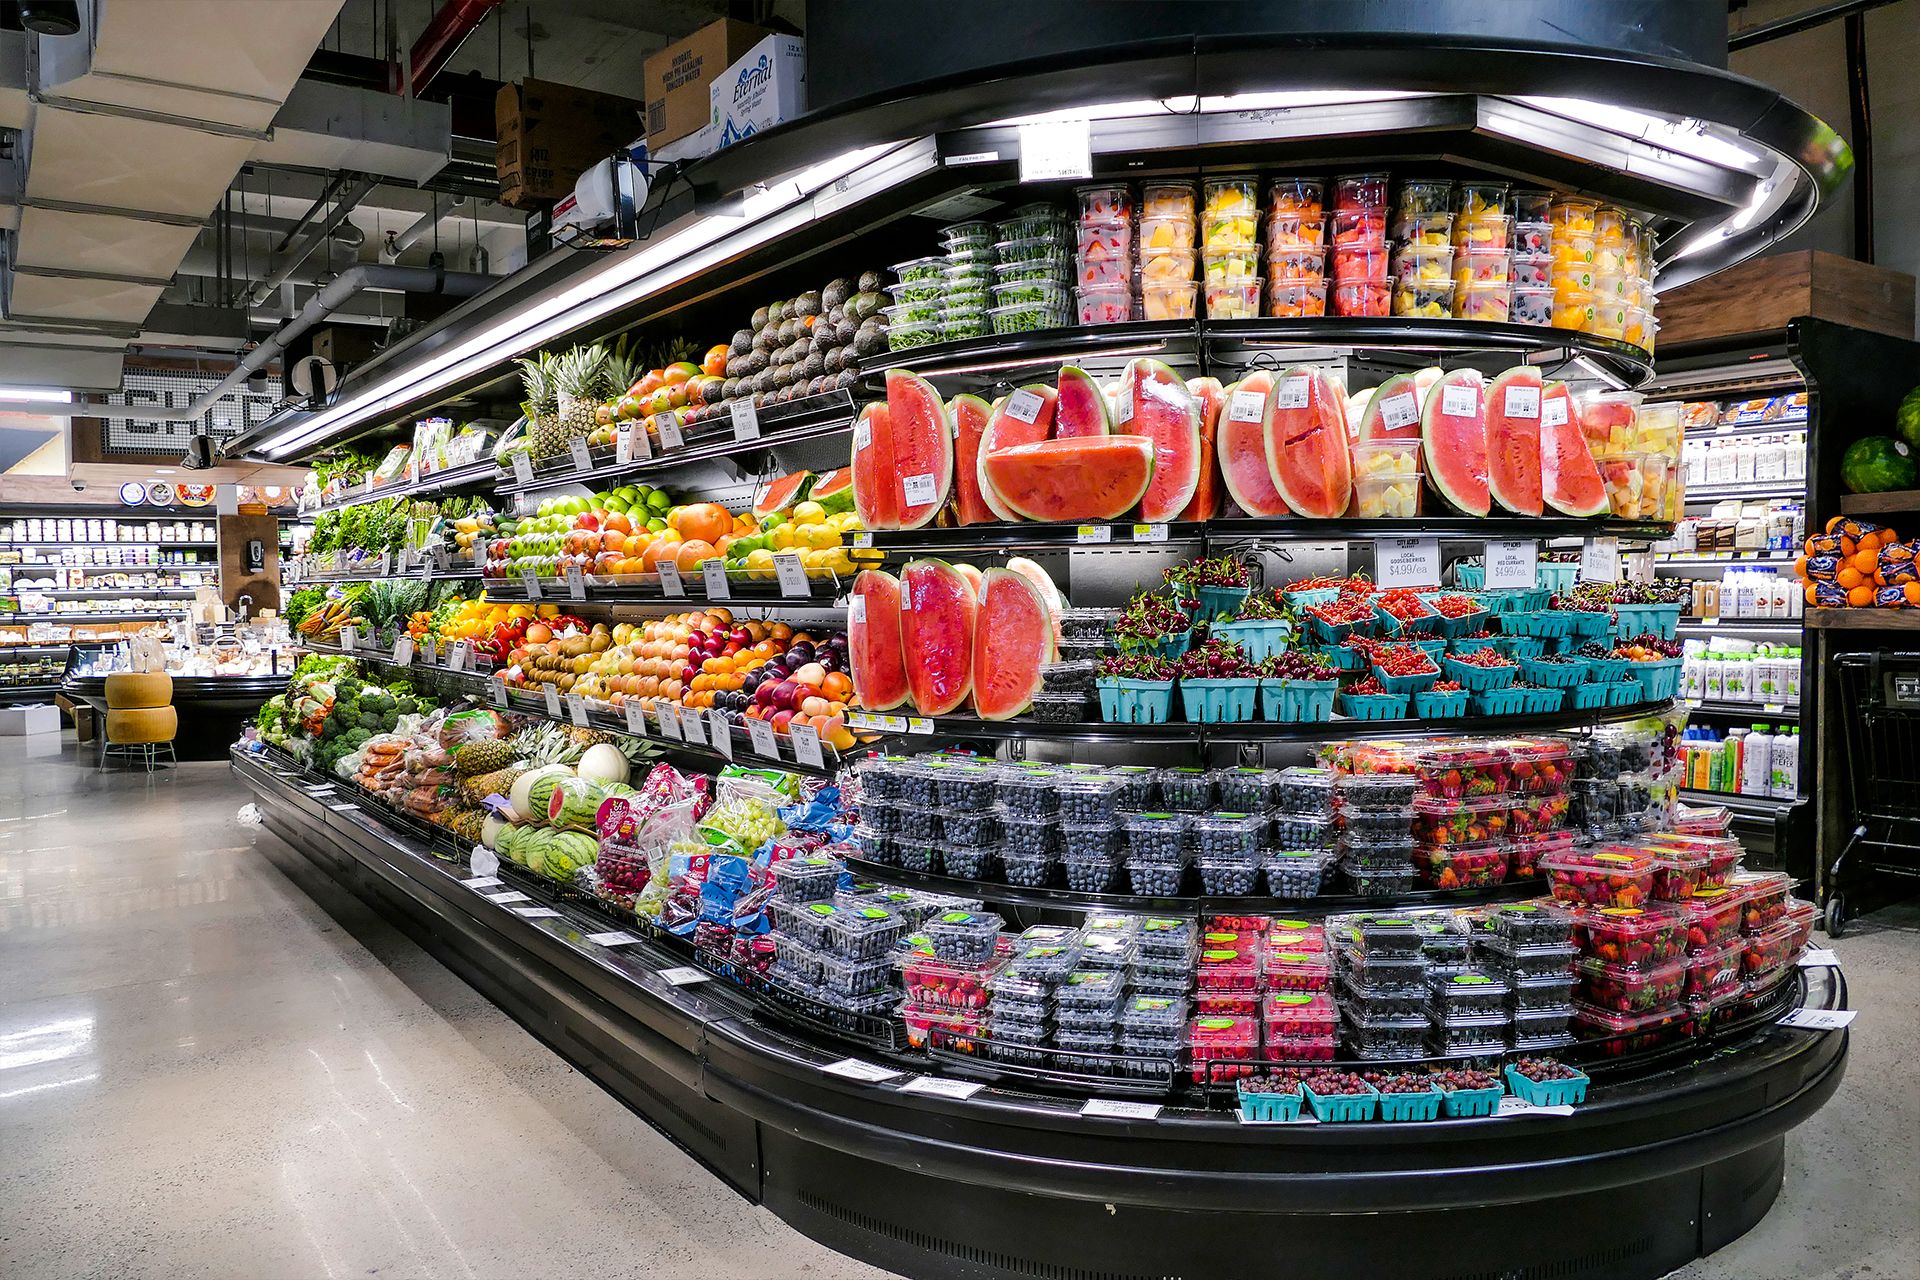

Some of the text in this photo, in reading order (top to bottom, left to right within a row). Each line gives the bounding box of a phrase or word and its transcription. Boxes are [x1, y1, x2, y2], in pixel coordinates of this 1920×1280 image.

[681, 55, 703, 75] ALKALINE
[685, 68, 701, 82] WATER
[733, 58, 773, 104] Eternal
[1389, 564, 1428, 576] $4.99/ea
[1495, 566, 1526, 577] $4.99/ea
